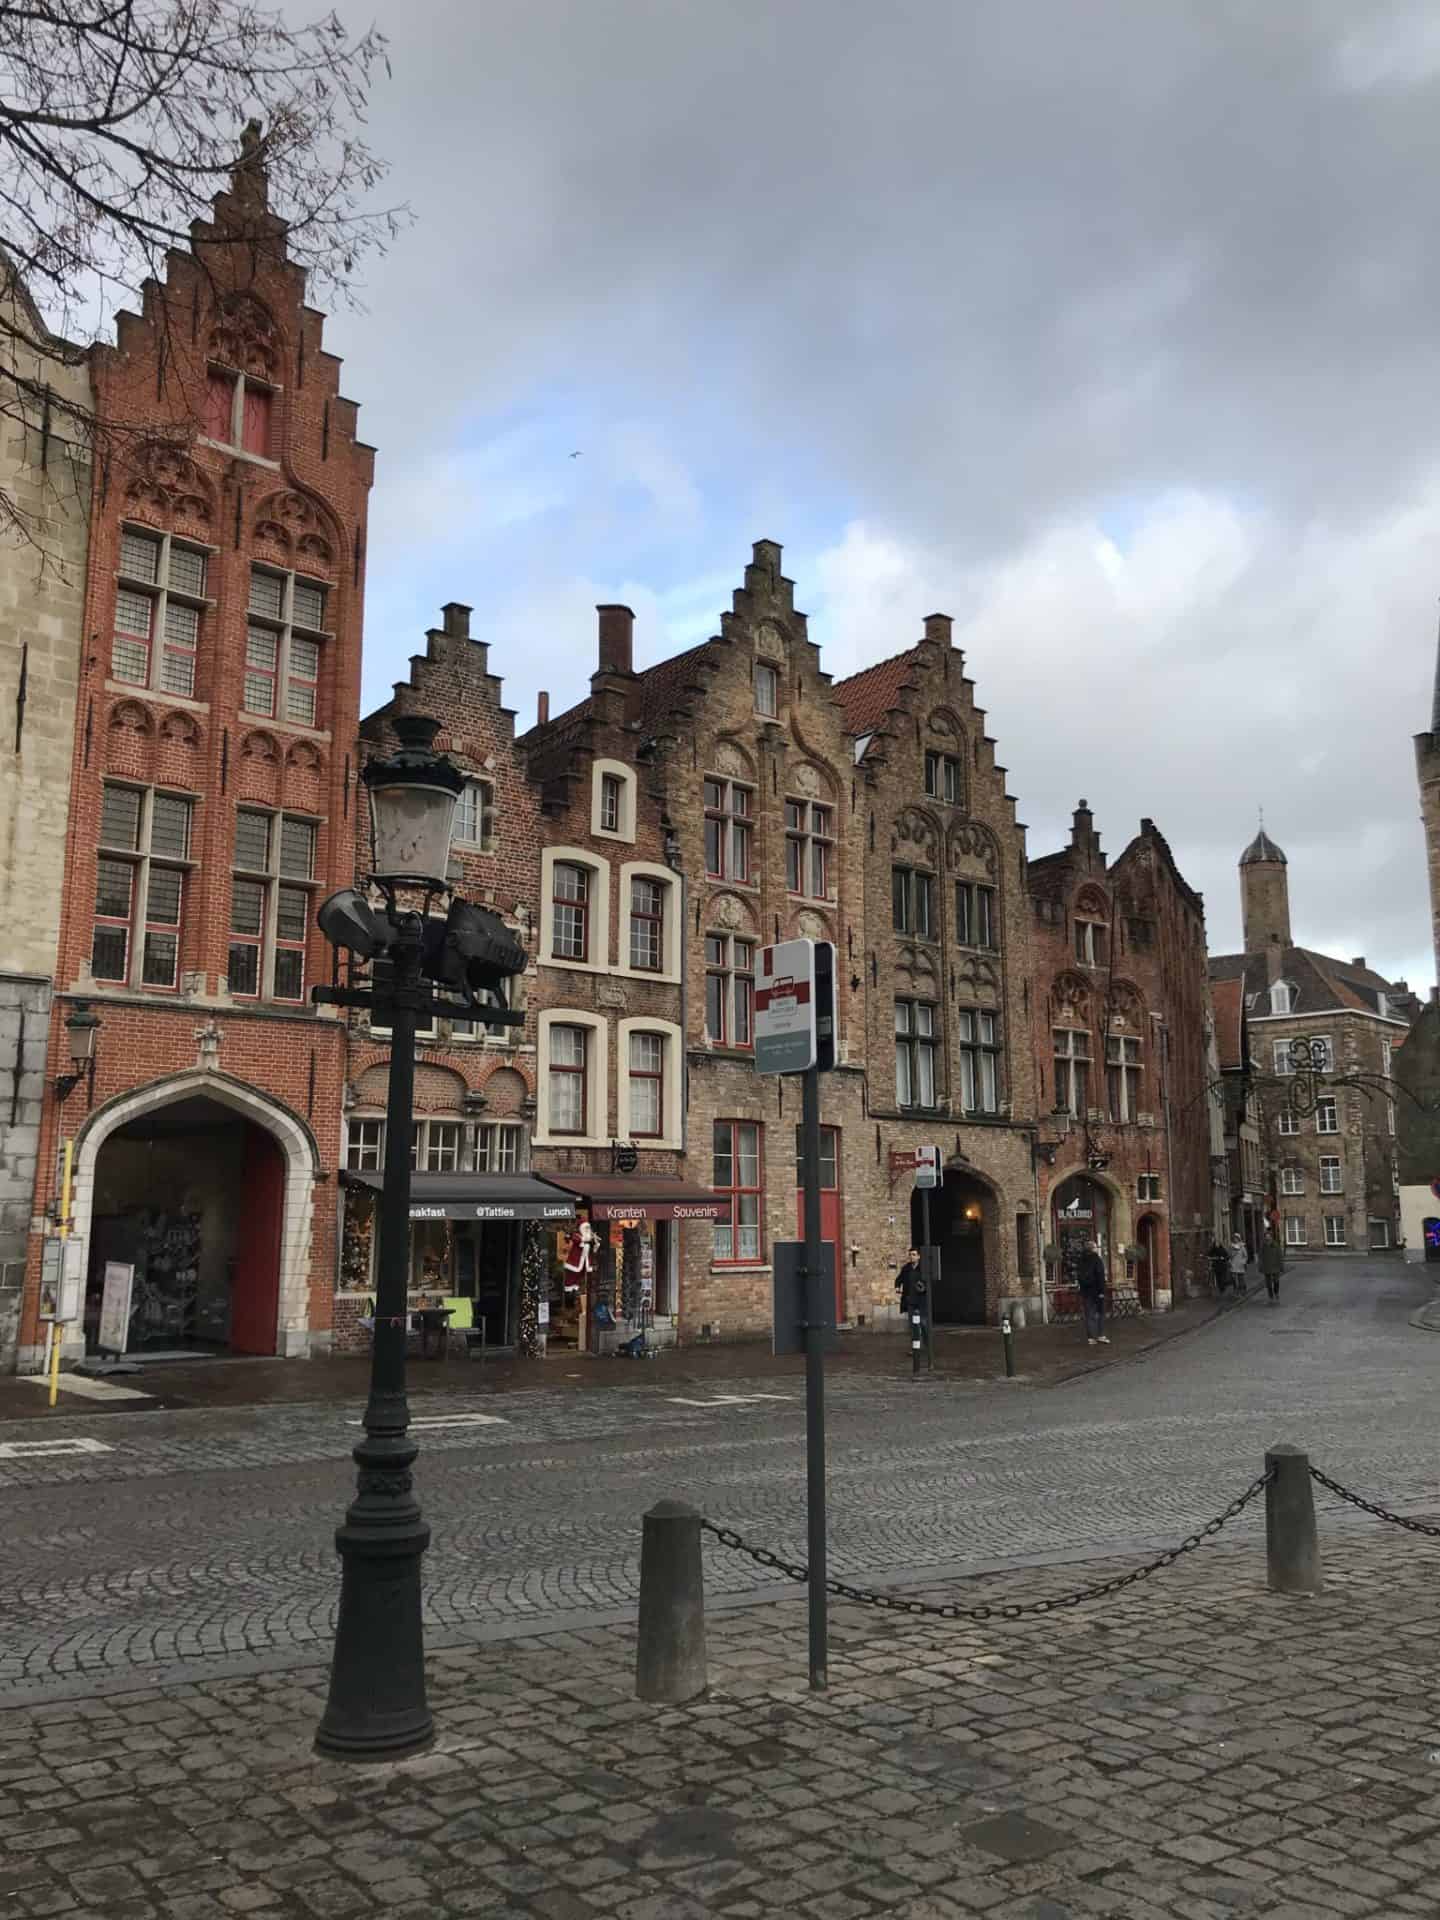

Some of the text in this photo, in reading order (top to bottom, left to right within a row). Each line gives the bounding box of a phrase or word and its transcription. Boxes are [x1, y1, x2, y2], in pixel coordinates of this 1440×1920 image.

[408, 1207, 446, 1217] eakfast
[543, 1207, 571, 1216] Lunch
[607, 1205, 718, 1218] Kranten Souvenirs
